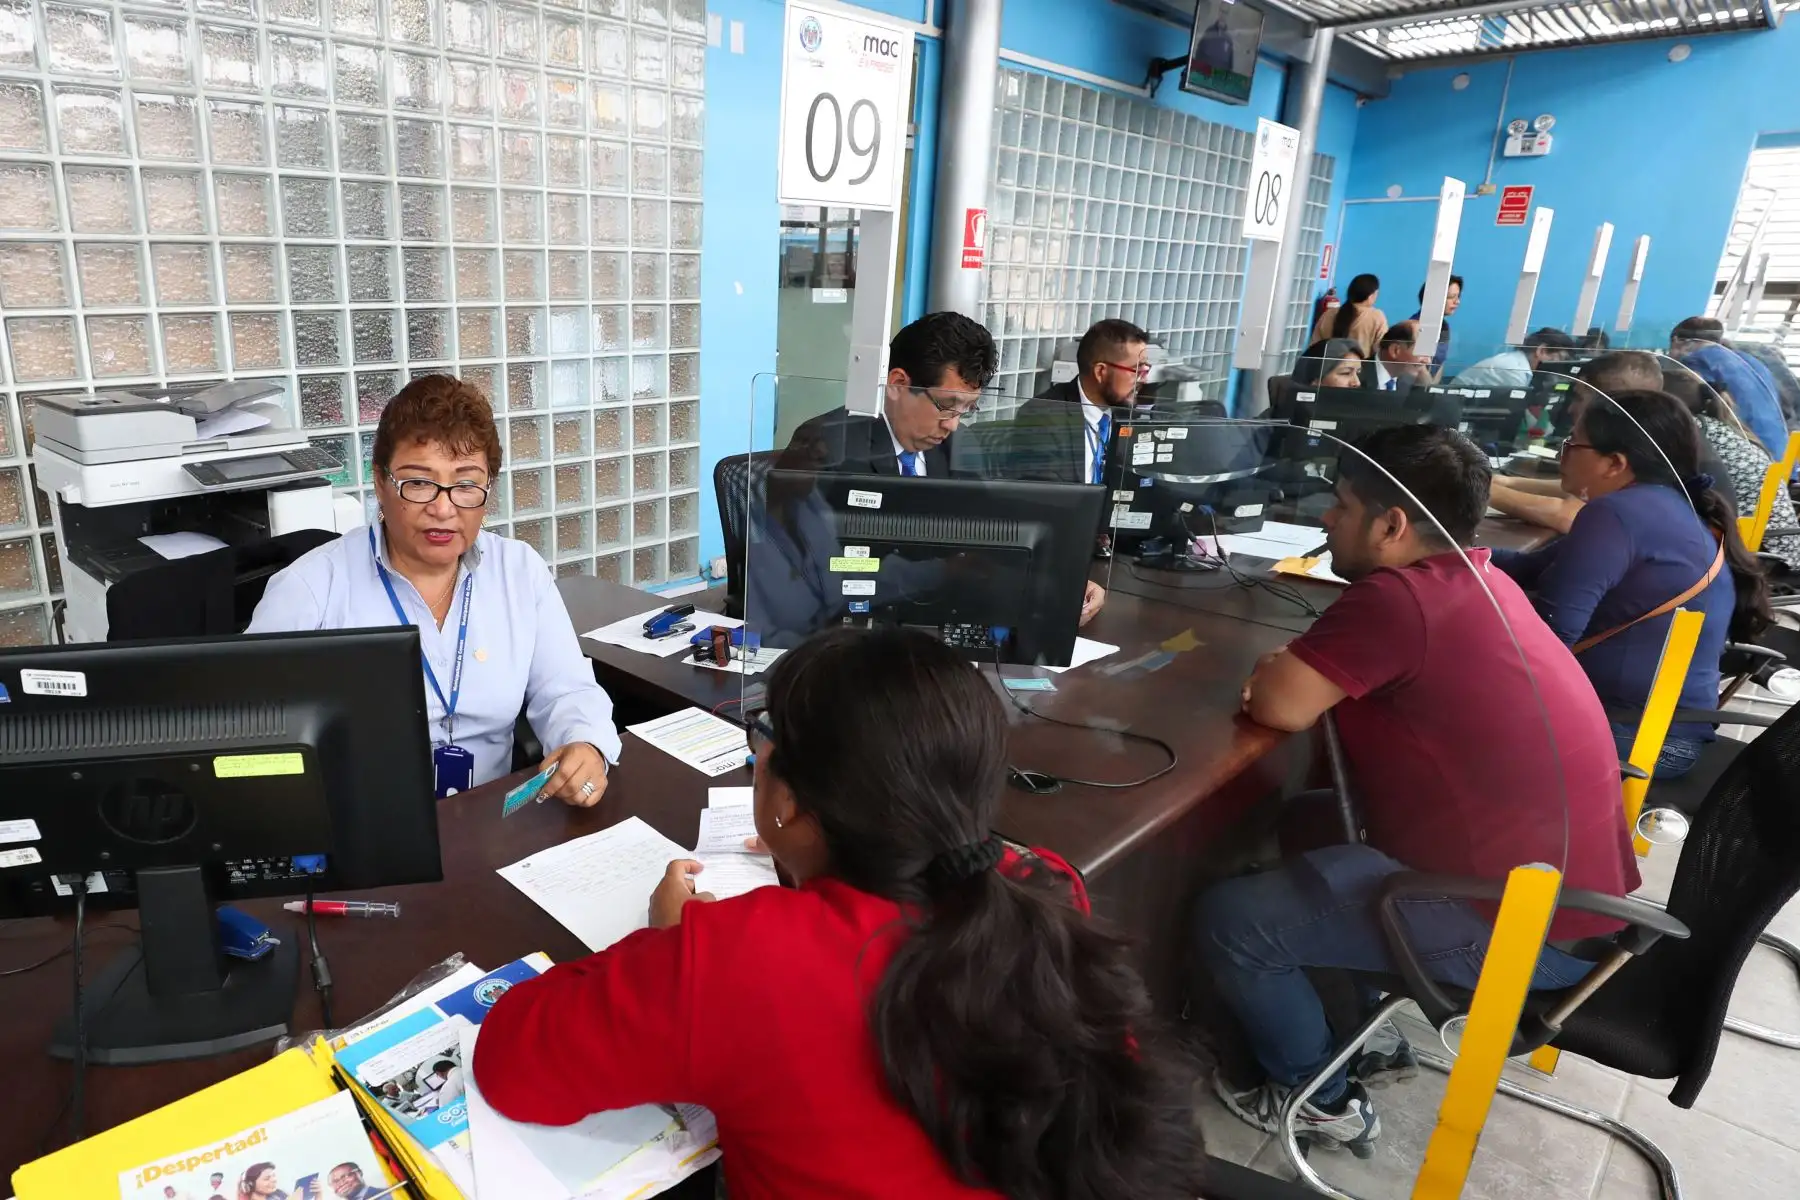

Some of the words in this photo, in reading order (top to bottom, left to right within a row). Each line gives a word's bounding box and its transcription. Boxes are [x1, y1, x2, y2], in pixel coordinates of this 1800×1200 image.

[863, 34, 899, 58] mac
[805, 92, 882, 186] 09
[1254, 170, 1282, 227] 08
[135, 1127, 268, 1190] ¡Despertad!
